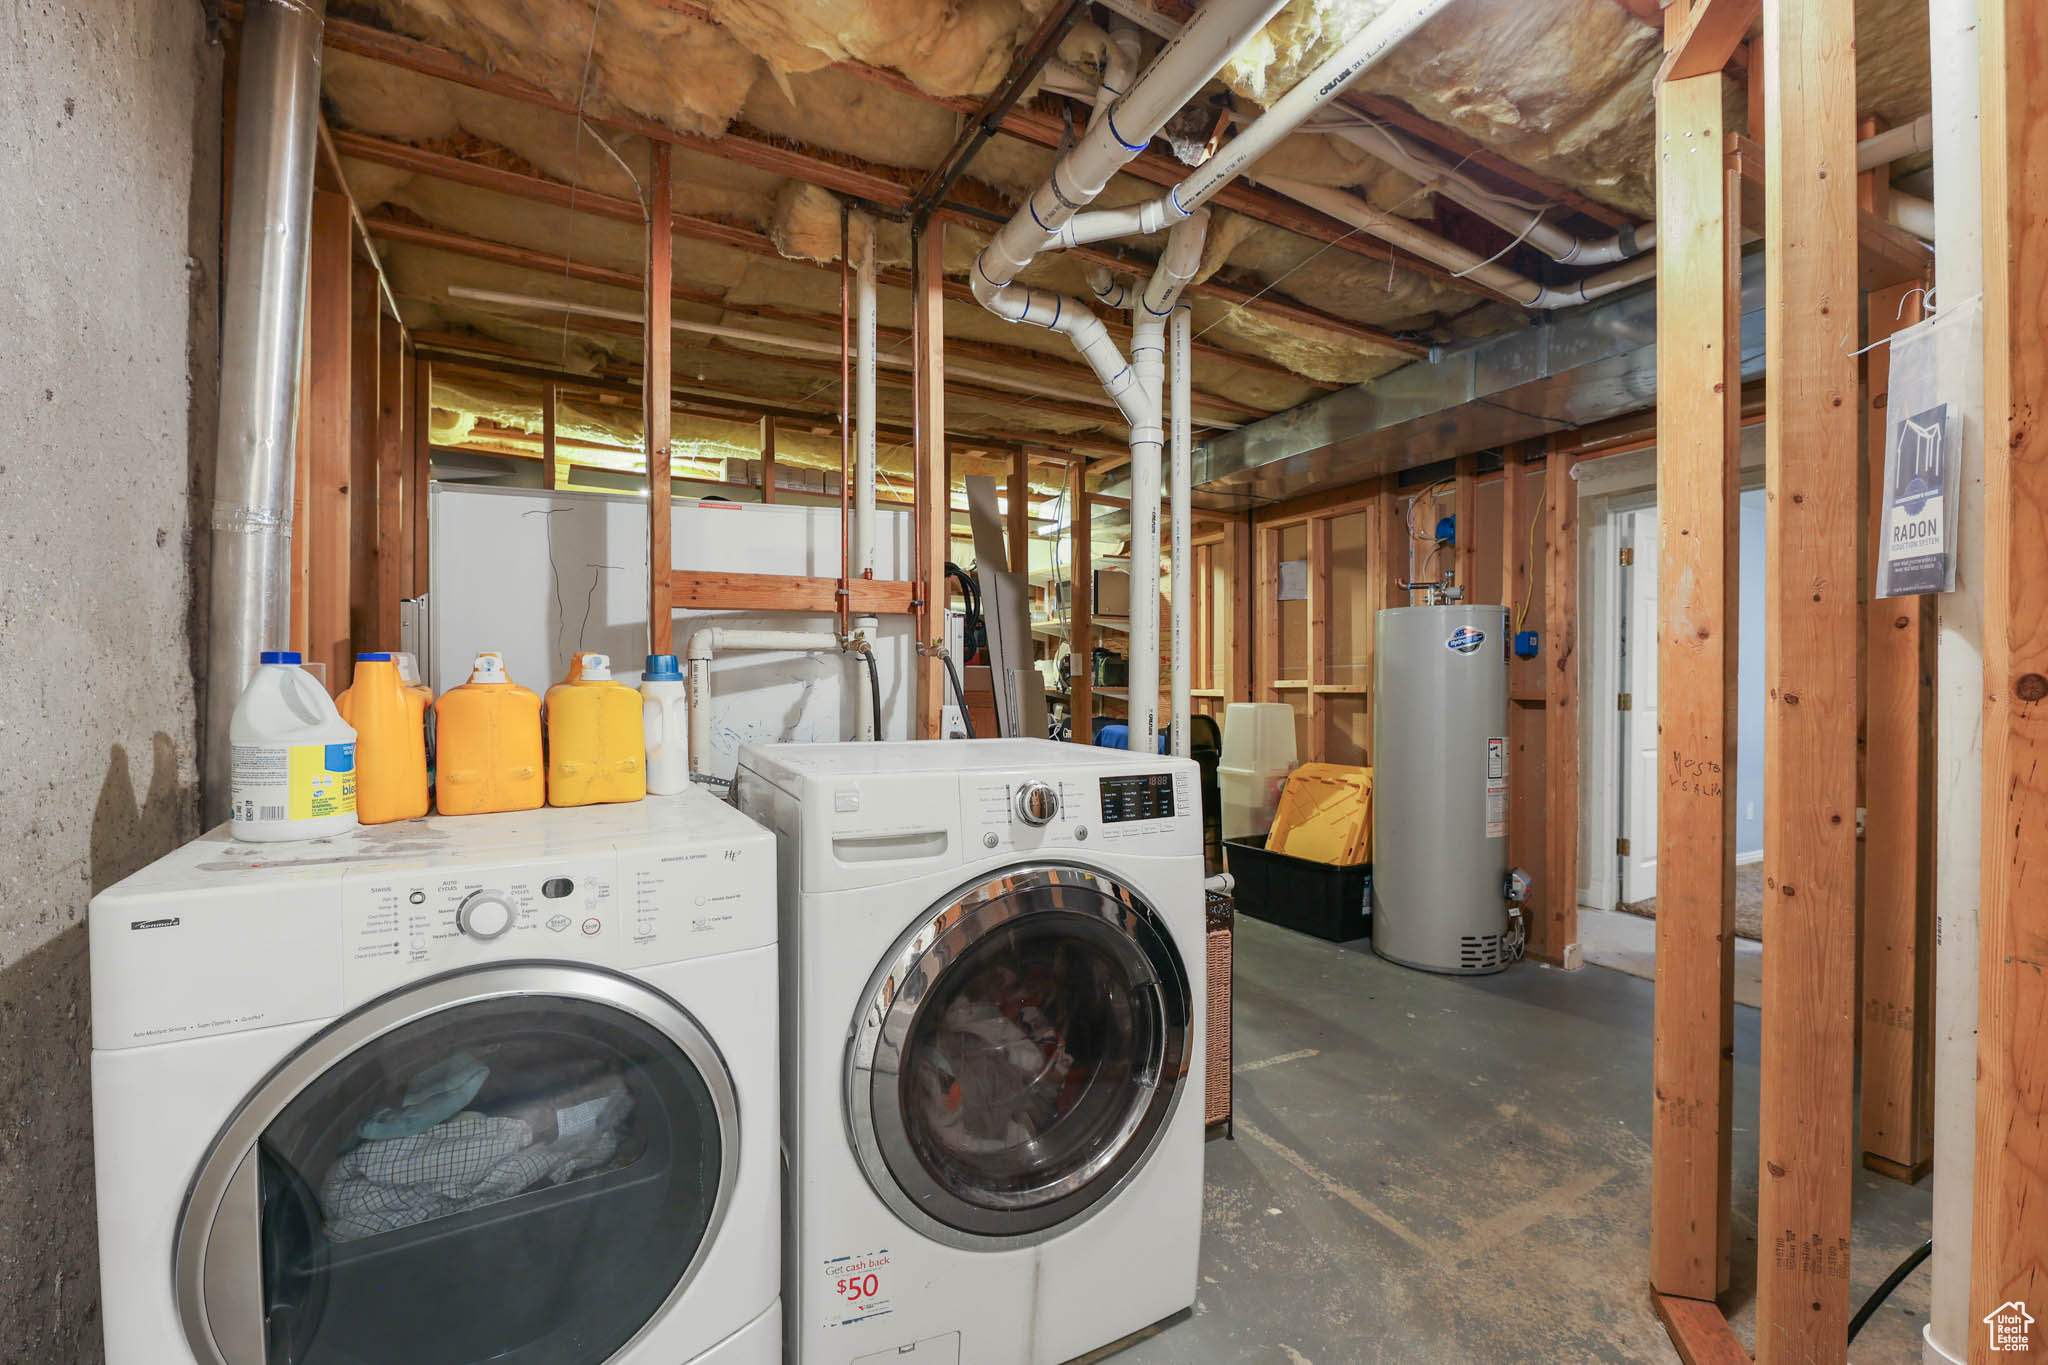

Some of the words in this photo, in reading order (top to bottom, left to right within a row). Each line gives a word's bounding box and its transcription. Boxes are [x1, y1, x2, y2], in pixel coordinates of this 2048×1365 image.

[1894, 519, 1937, 542] RADON
[137, 918, 180, 930] Kenmore
[825, 1265, 845, 1277] Get
[845, 1260, 866, 1273] cash
[868, 1256, 891, 1268] back
[836, 1273, 879, 1301] $50
